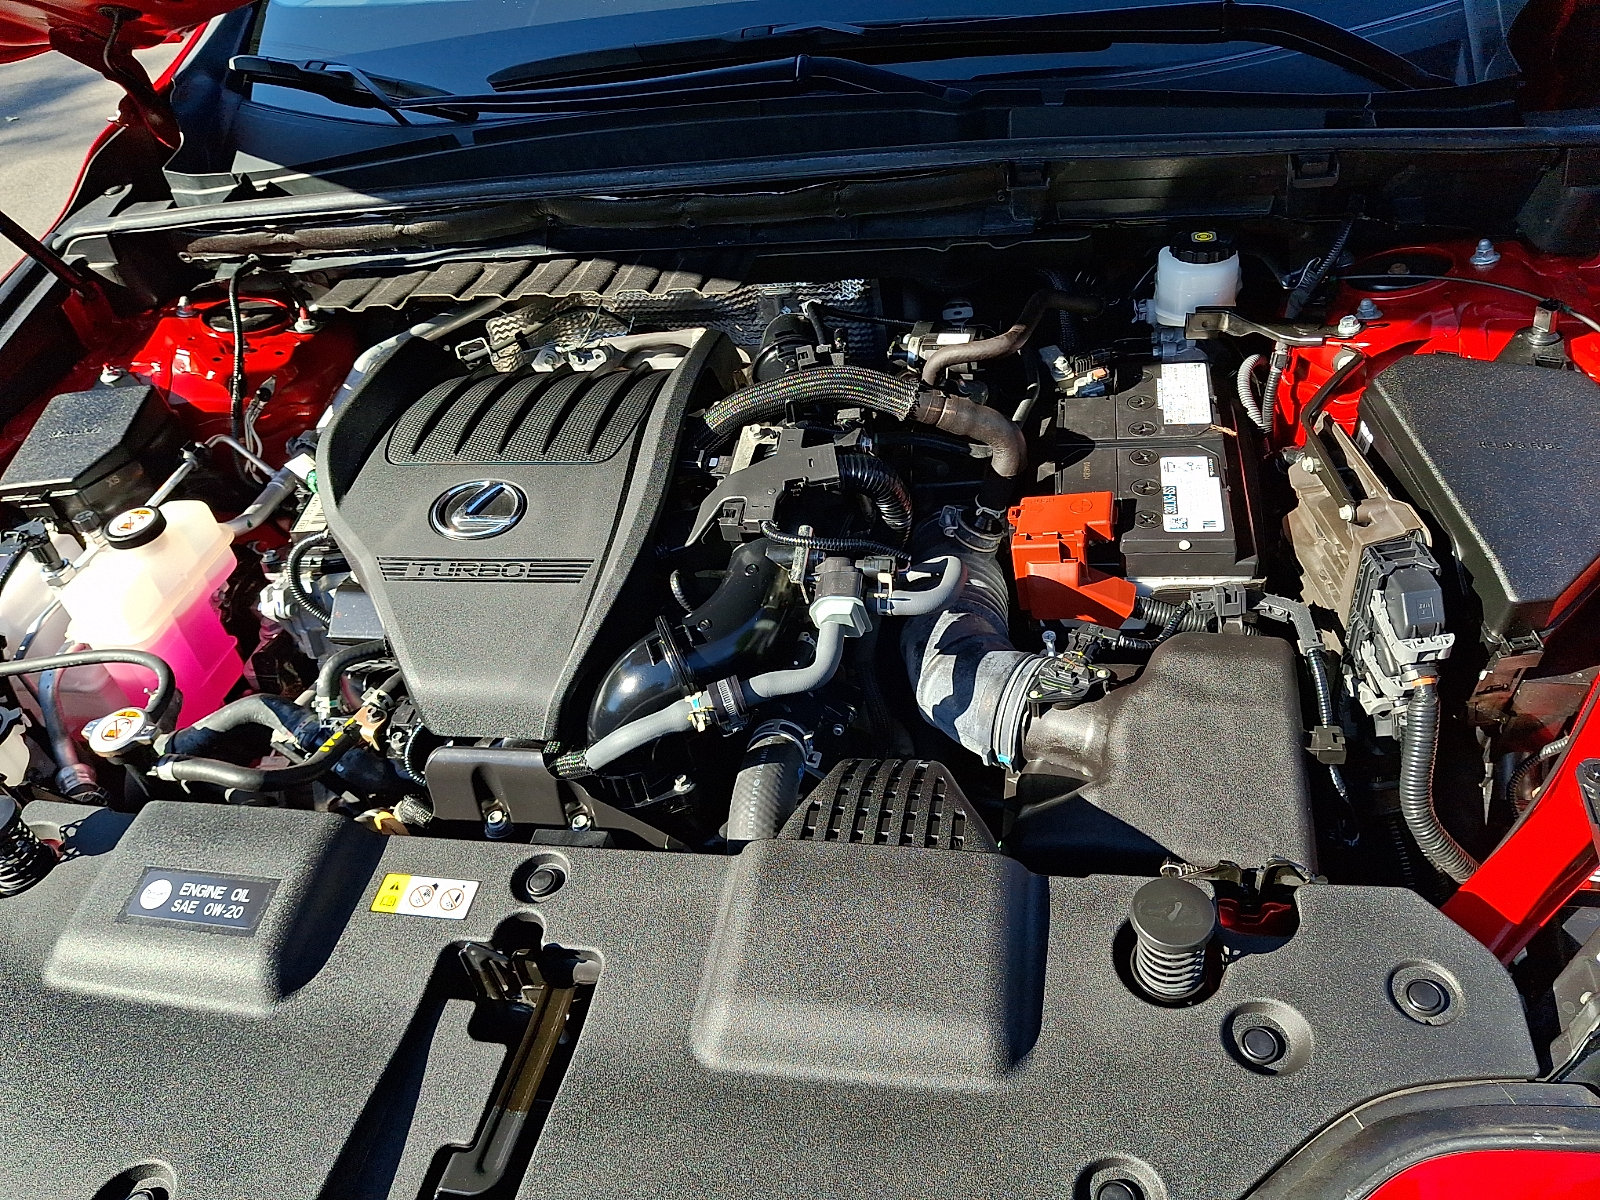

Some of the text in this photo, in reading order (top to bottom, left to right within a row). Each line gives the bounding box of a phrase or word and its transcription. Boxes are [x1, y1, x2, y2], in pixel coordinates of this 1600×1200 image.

[411, 561, 527, 578] TURBO
[179, 882, 250, 903] ENGINE OIL
[171, 899, 200, 914] SAE
